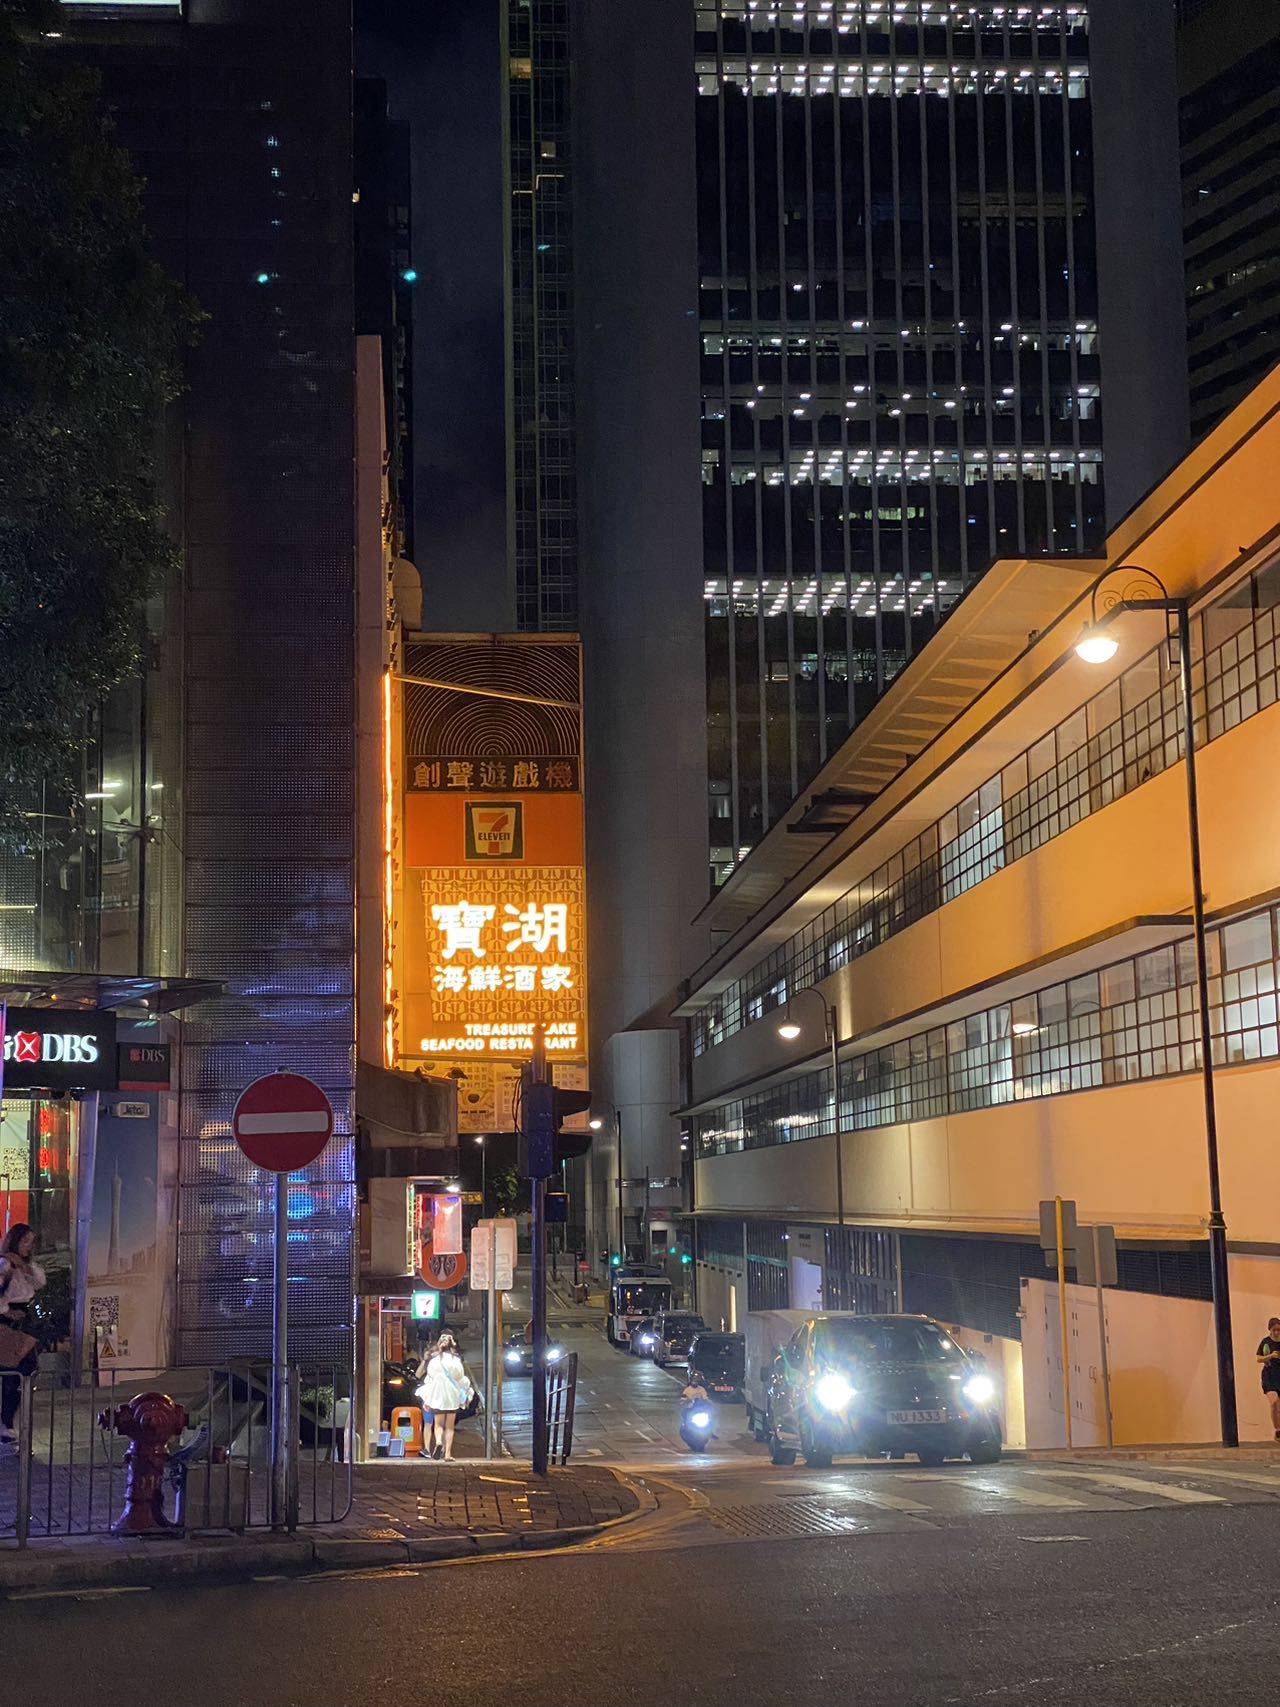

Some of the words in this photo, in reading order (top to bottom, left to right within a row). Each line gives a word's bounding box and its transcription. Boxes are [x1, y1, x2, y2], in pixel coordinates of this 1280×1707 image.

[413, 761, 573, 788] 創聲遊戲機
[478, 812, 509, 854] 7
[432, 900, 568, 959] 寶湖
[433, 965, 574, 992] 海鮮酒家
[465, 1023, 535, 1036] TREASURE
[42, 1033, 98, 1063] DBS
[141, 1048, 165, 1062] DBS
[420, 1038, 485, 1051] SEAFOOD
[490, 1037, 578, 1050] RESTARANT
